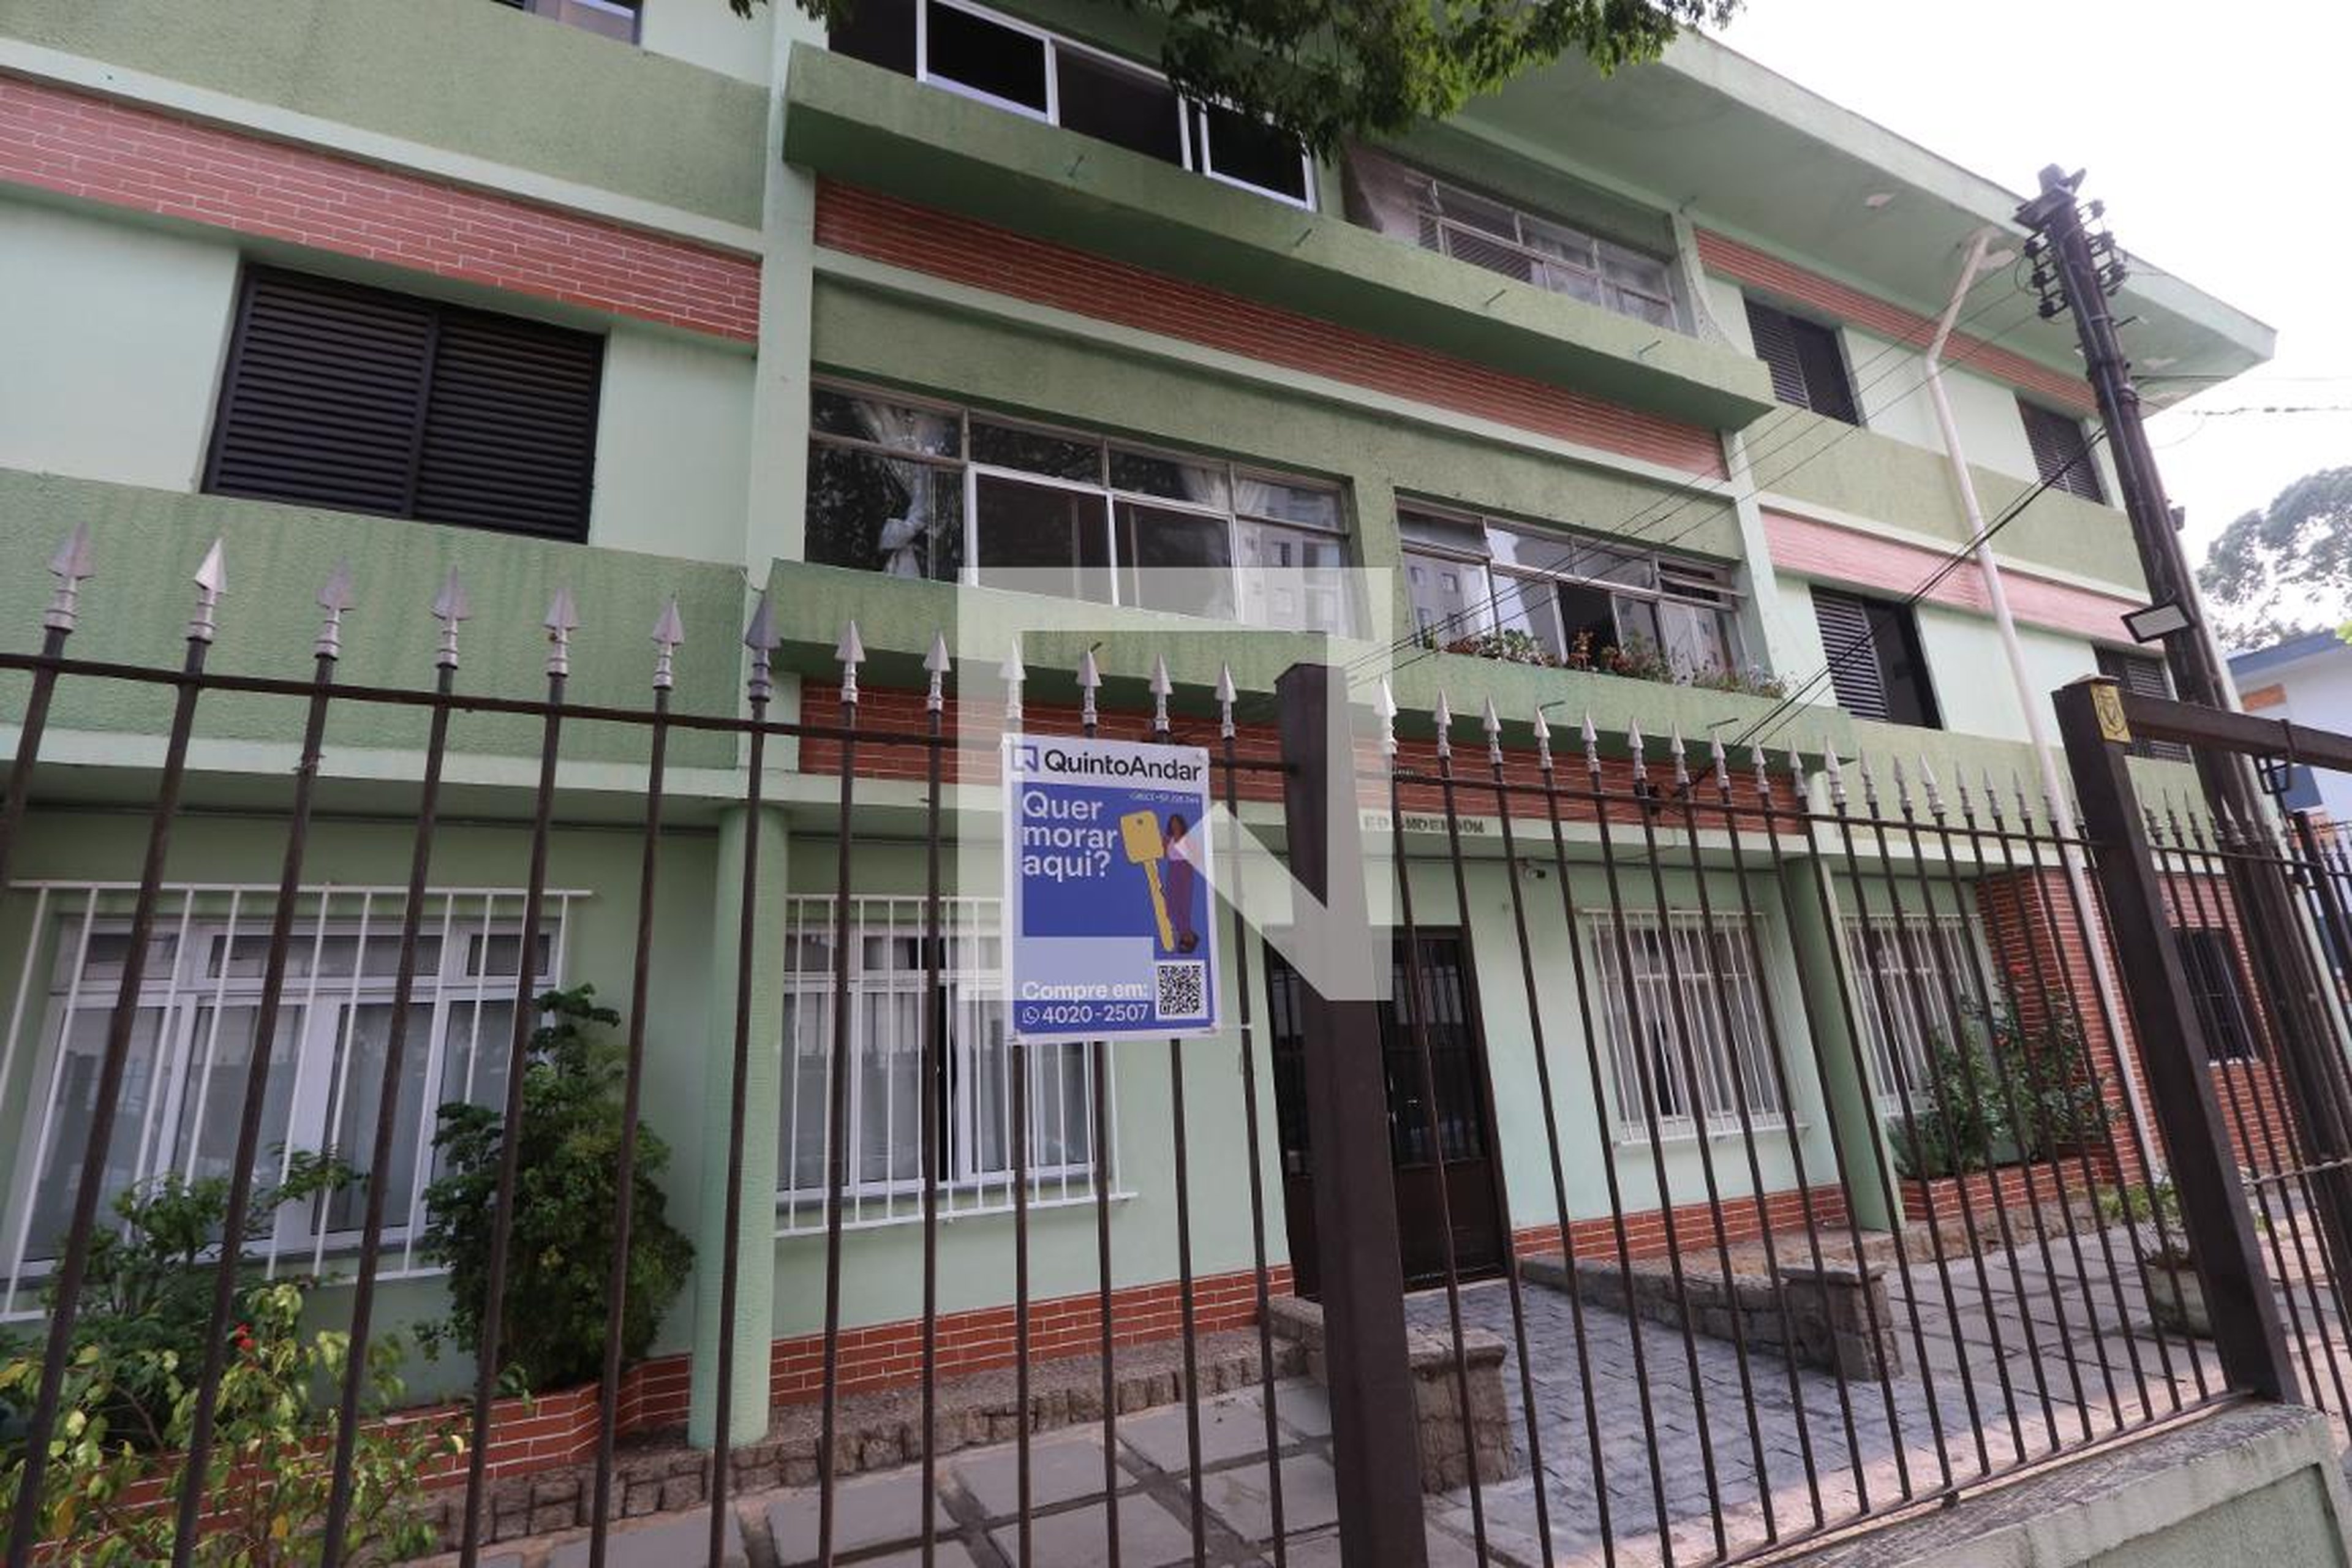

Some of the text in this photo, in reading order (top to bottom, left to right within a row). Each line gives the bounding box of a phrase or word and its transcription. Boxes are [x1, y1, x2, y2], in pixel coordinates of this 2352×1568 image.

[1044, 748, 1202, 781] QuintoAndar
[1022, 791, 1102, 821] Quer
[1023, 825, 1118, 849] morar
[1023, 851, 1110, 882] aqui?
[1022, 982, 1148, 1002] Compre em:
[1042, 1005, 1148, 1023] 4020-2507
